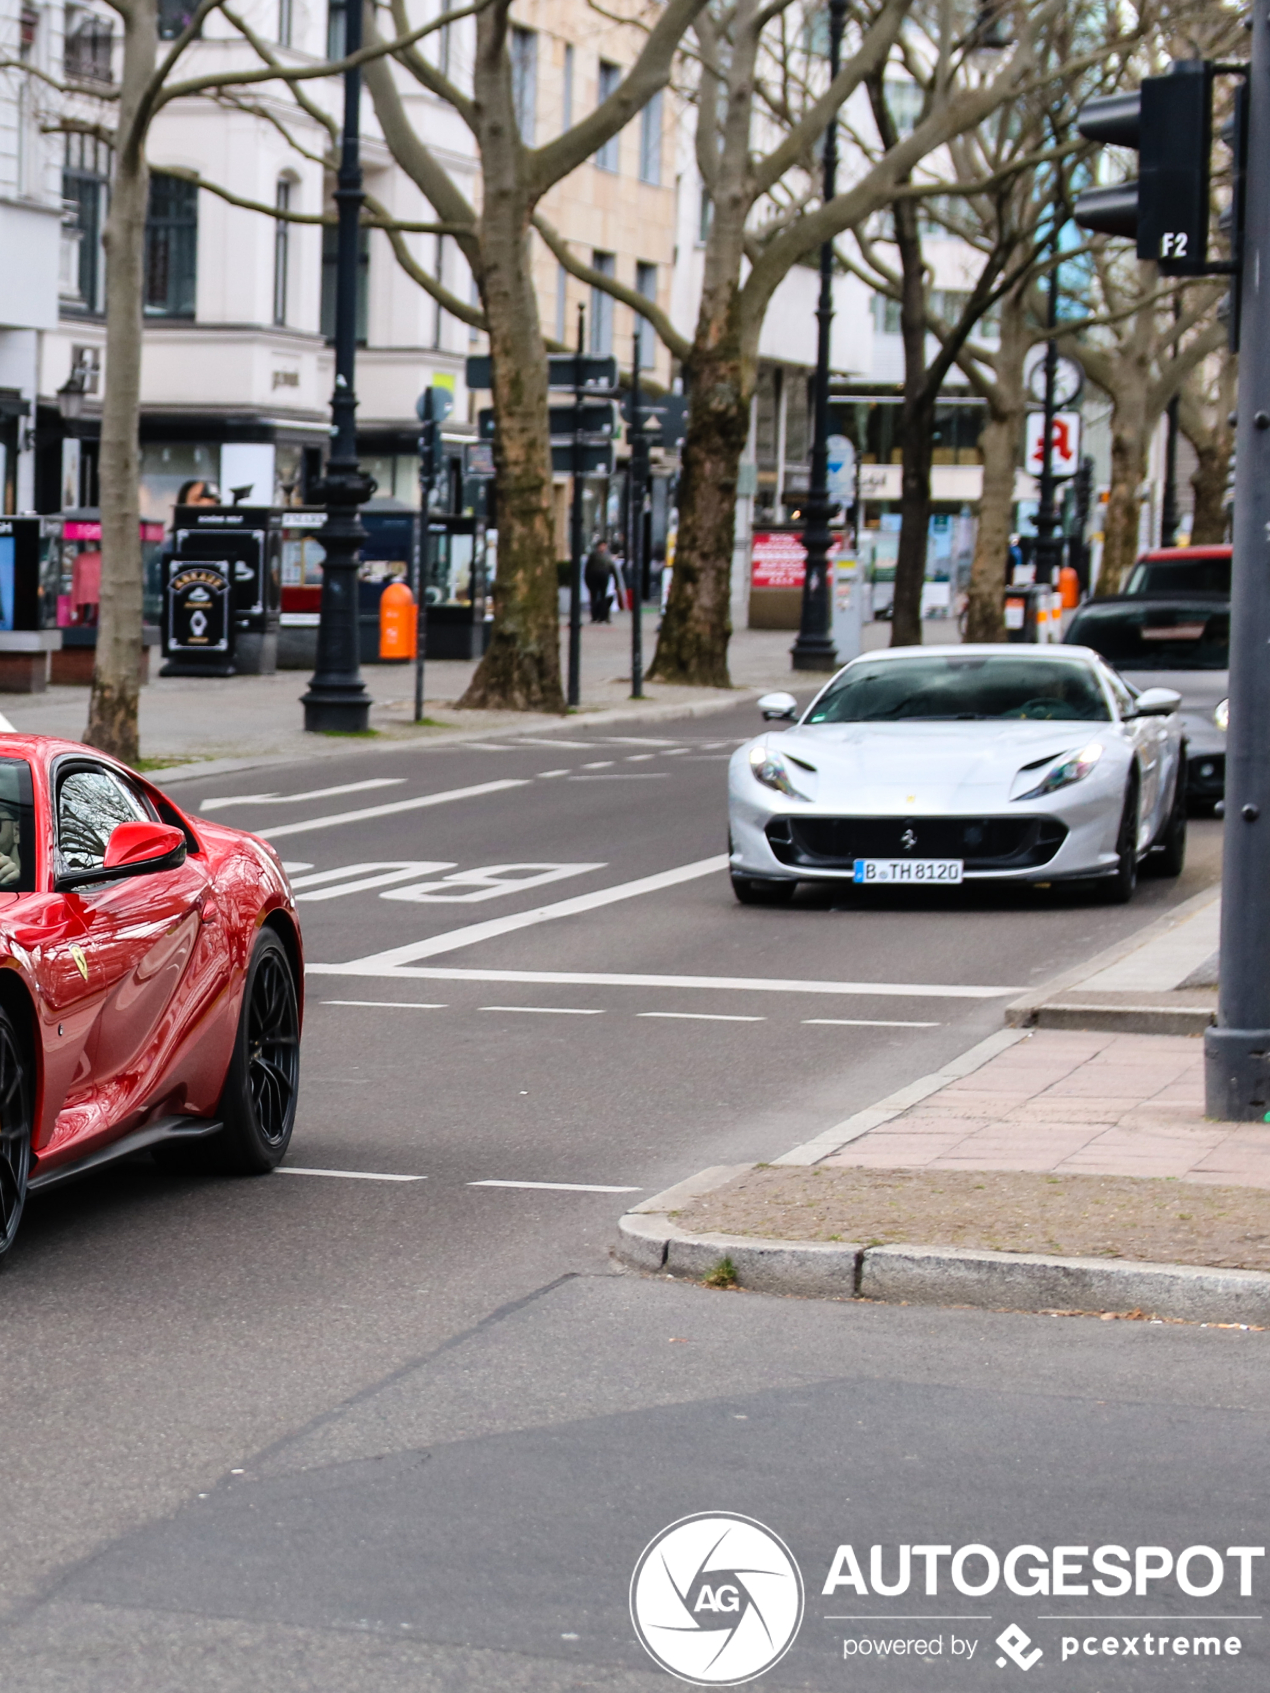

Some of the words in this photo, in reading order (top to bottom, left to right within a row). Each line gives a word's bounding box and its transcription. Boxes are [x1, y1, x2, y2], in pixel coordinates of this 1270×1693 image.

[1161, 232, 1189, 257] F2
[281, 861, 608, 902] BU
[865, 864, 877, 879] B
[889, 864, 912, 879] TH
[915, 864, 959, 880] 8120
